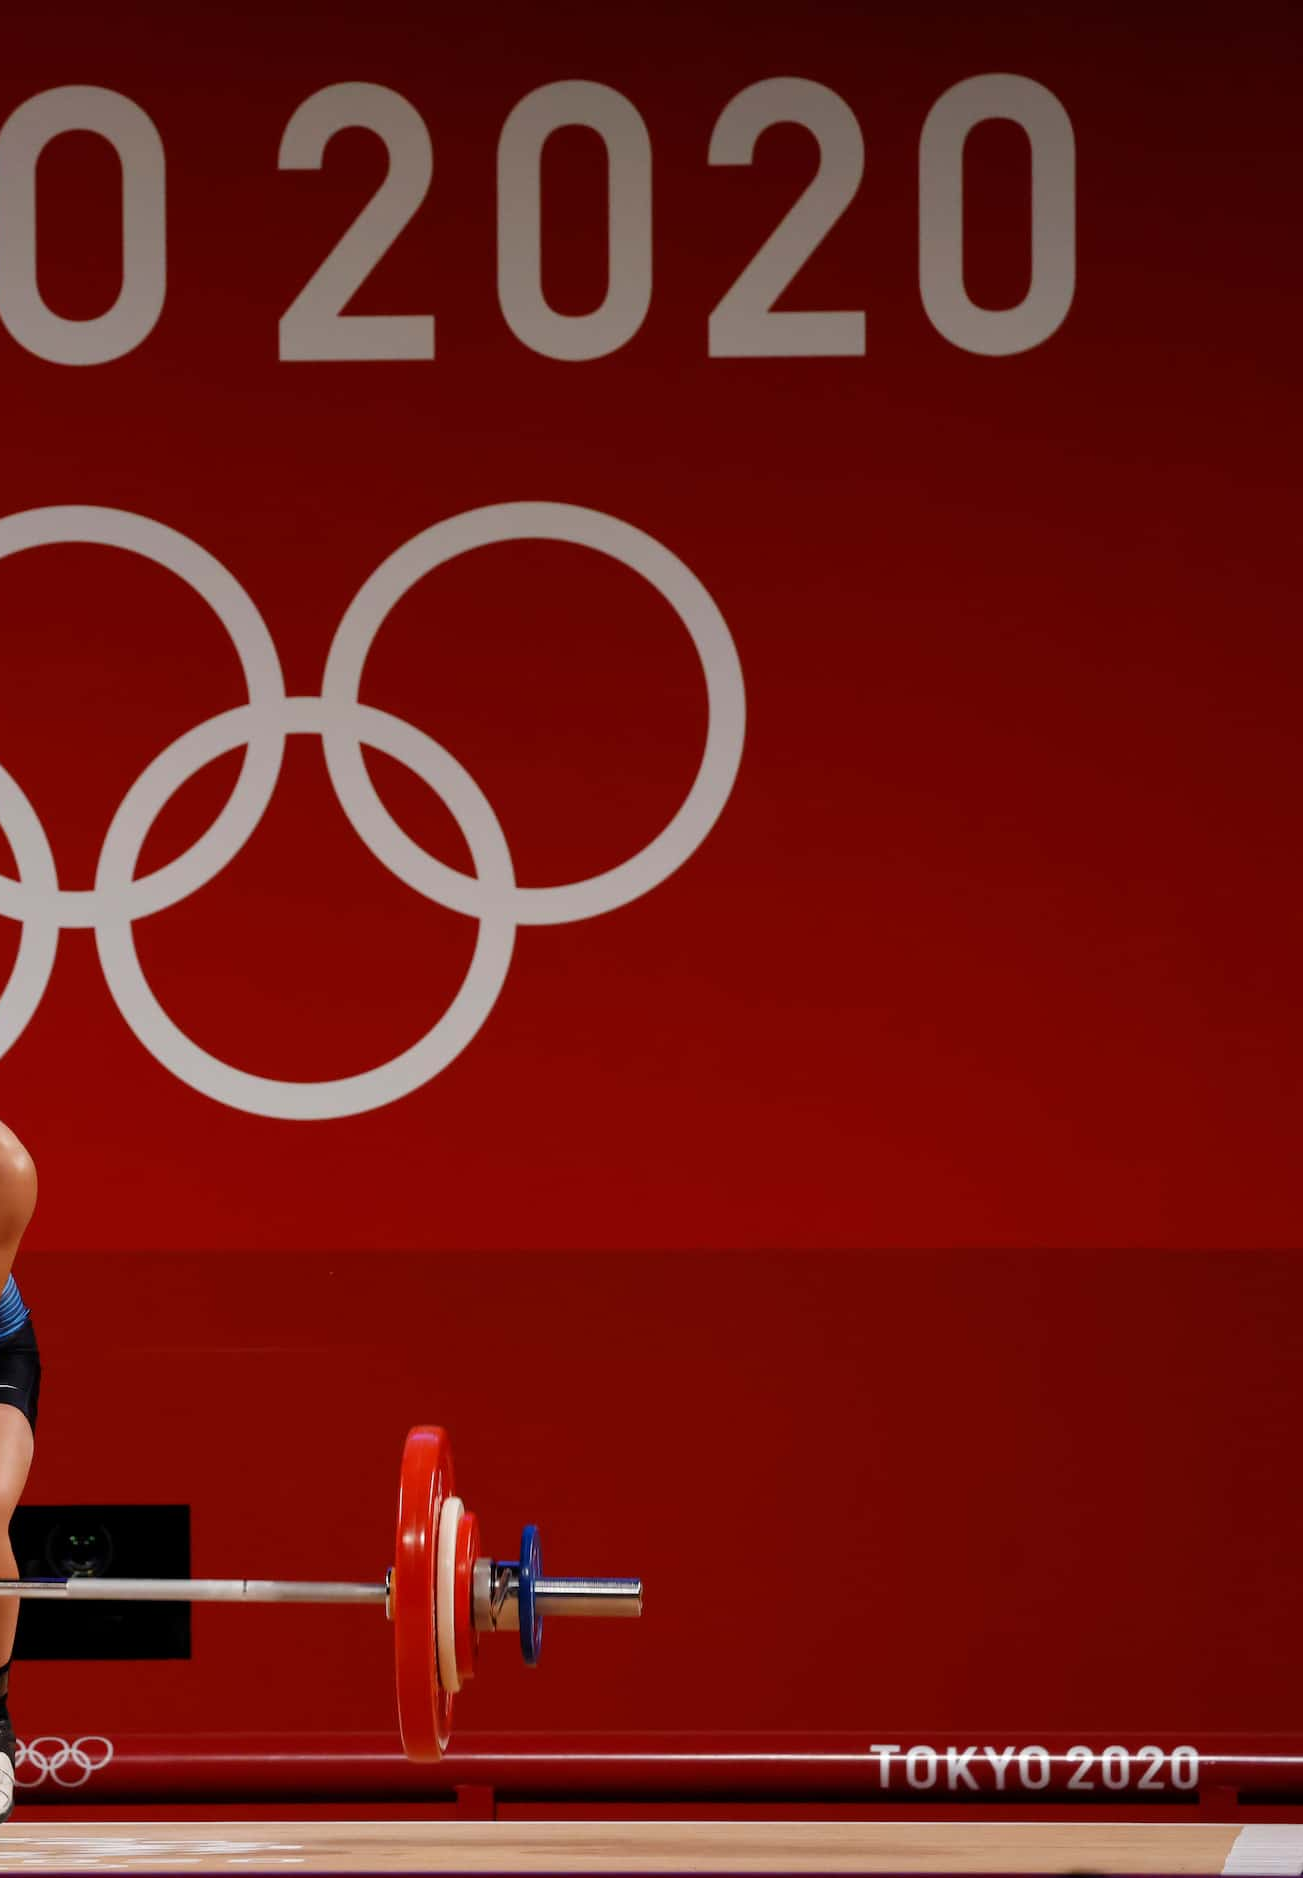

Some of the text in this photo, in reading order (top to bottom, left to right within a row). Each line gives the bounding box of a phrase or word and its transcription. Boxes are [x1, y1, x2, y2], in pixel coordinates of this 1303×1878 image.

[278, 74, 1075, 361] 2020
[870, 1745, 1199, 1790] TOKYO 2020
